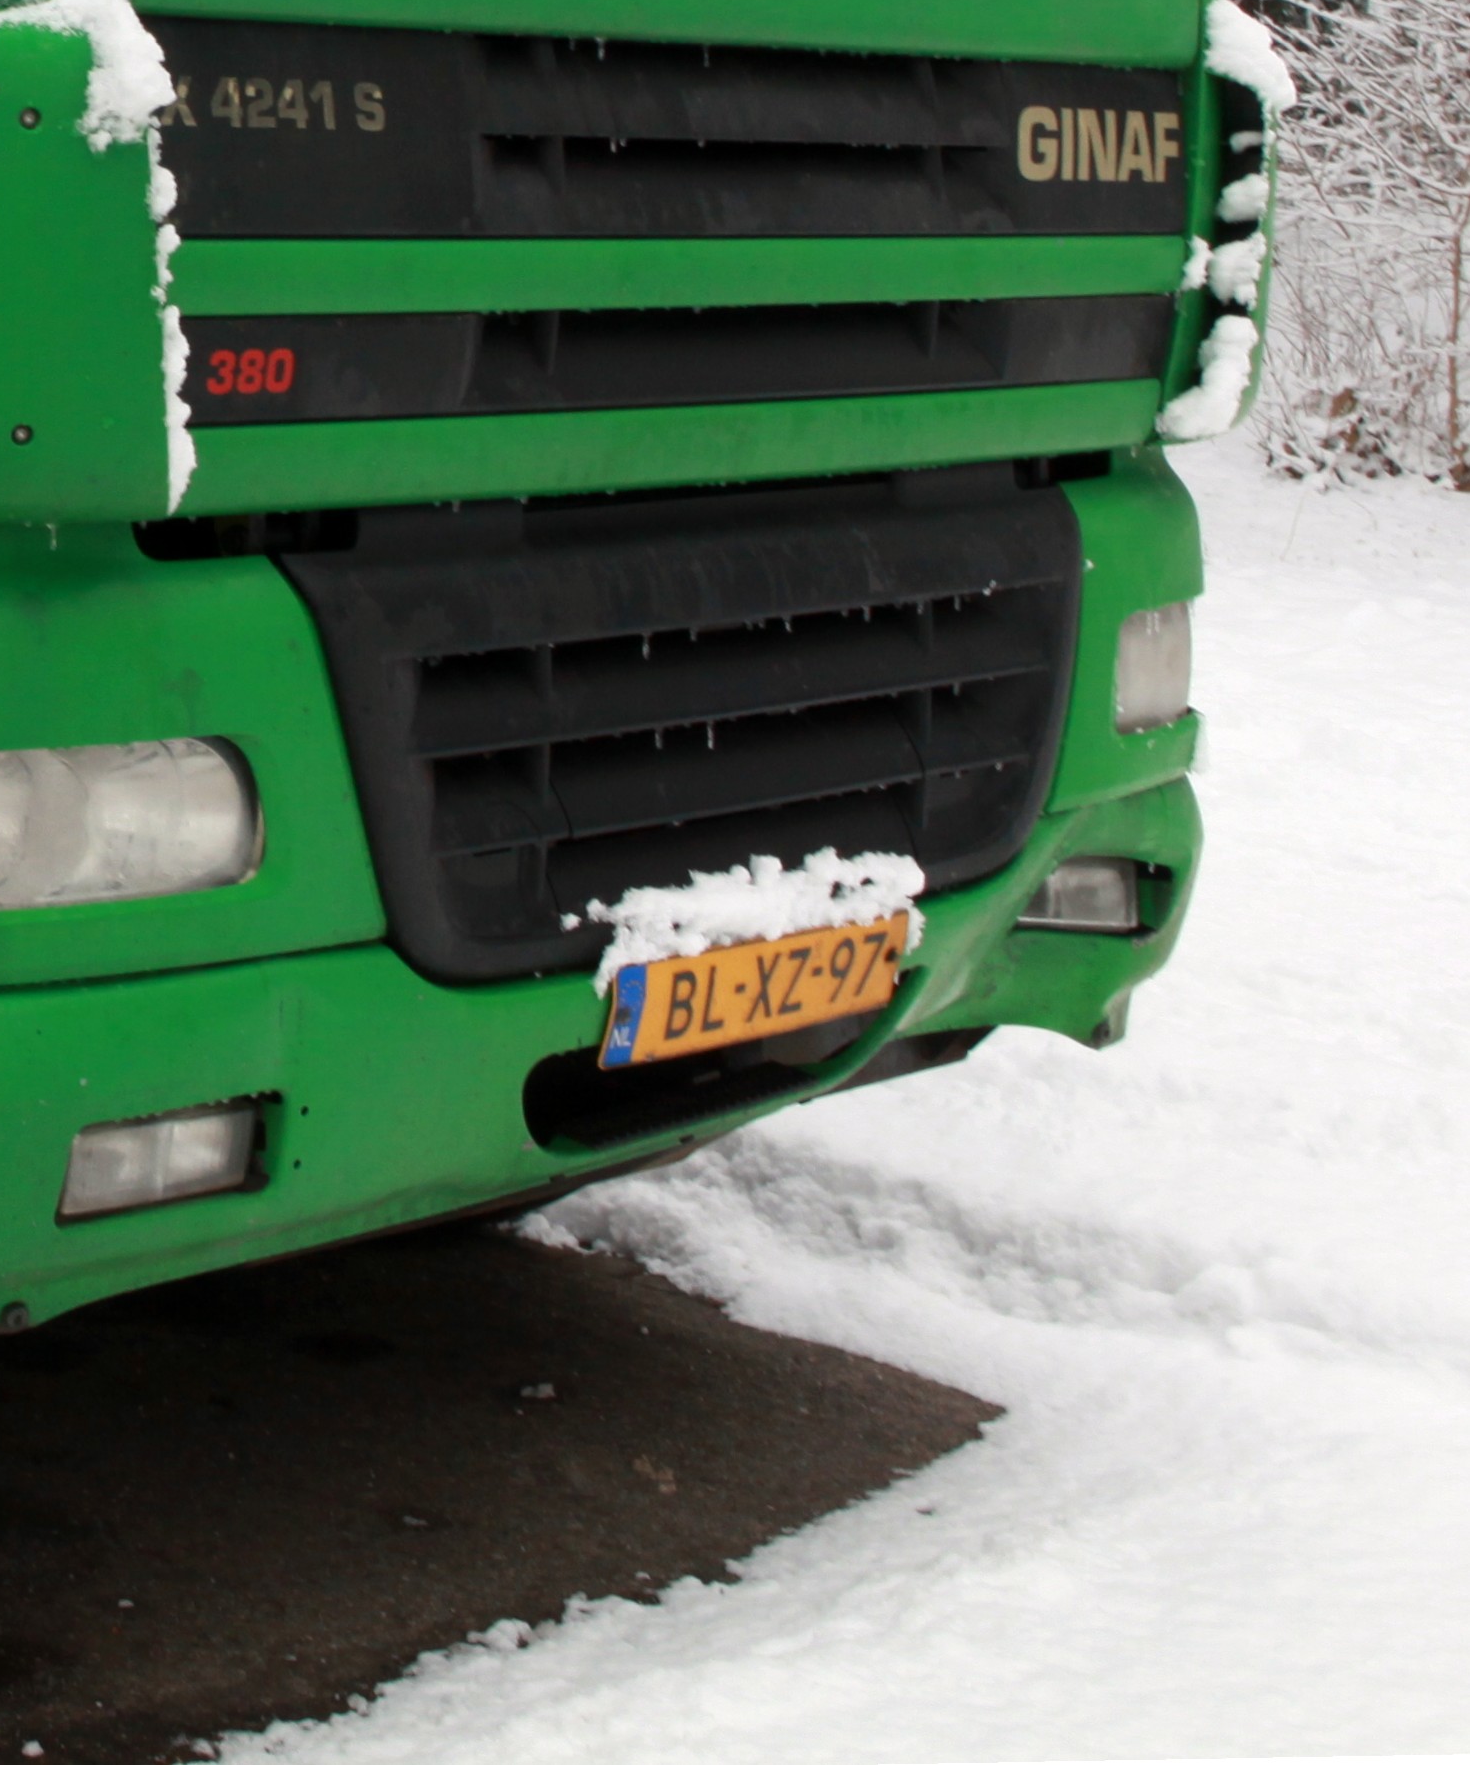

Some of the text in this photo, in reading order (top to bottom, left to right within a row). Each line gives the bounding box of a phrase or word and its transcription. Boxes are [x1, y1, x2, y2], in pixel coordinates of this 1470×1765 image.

[211, 76, 336, 130] 4241
[353, 82, 387, 132] S
[1017, 105, 1180, 183] GINAF
[206, 348, 295, 396] 380
[664, 932, 889, 1041] BL-XZ-97
[609, 1026, 631, 1049] NL
